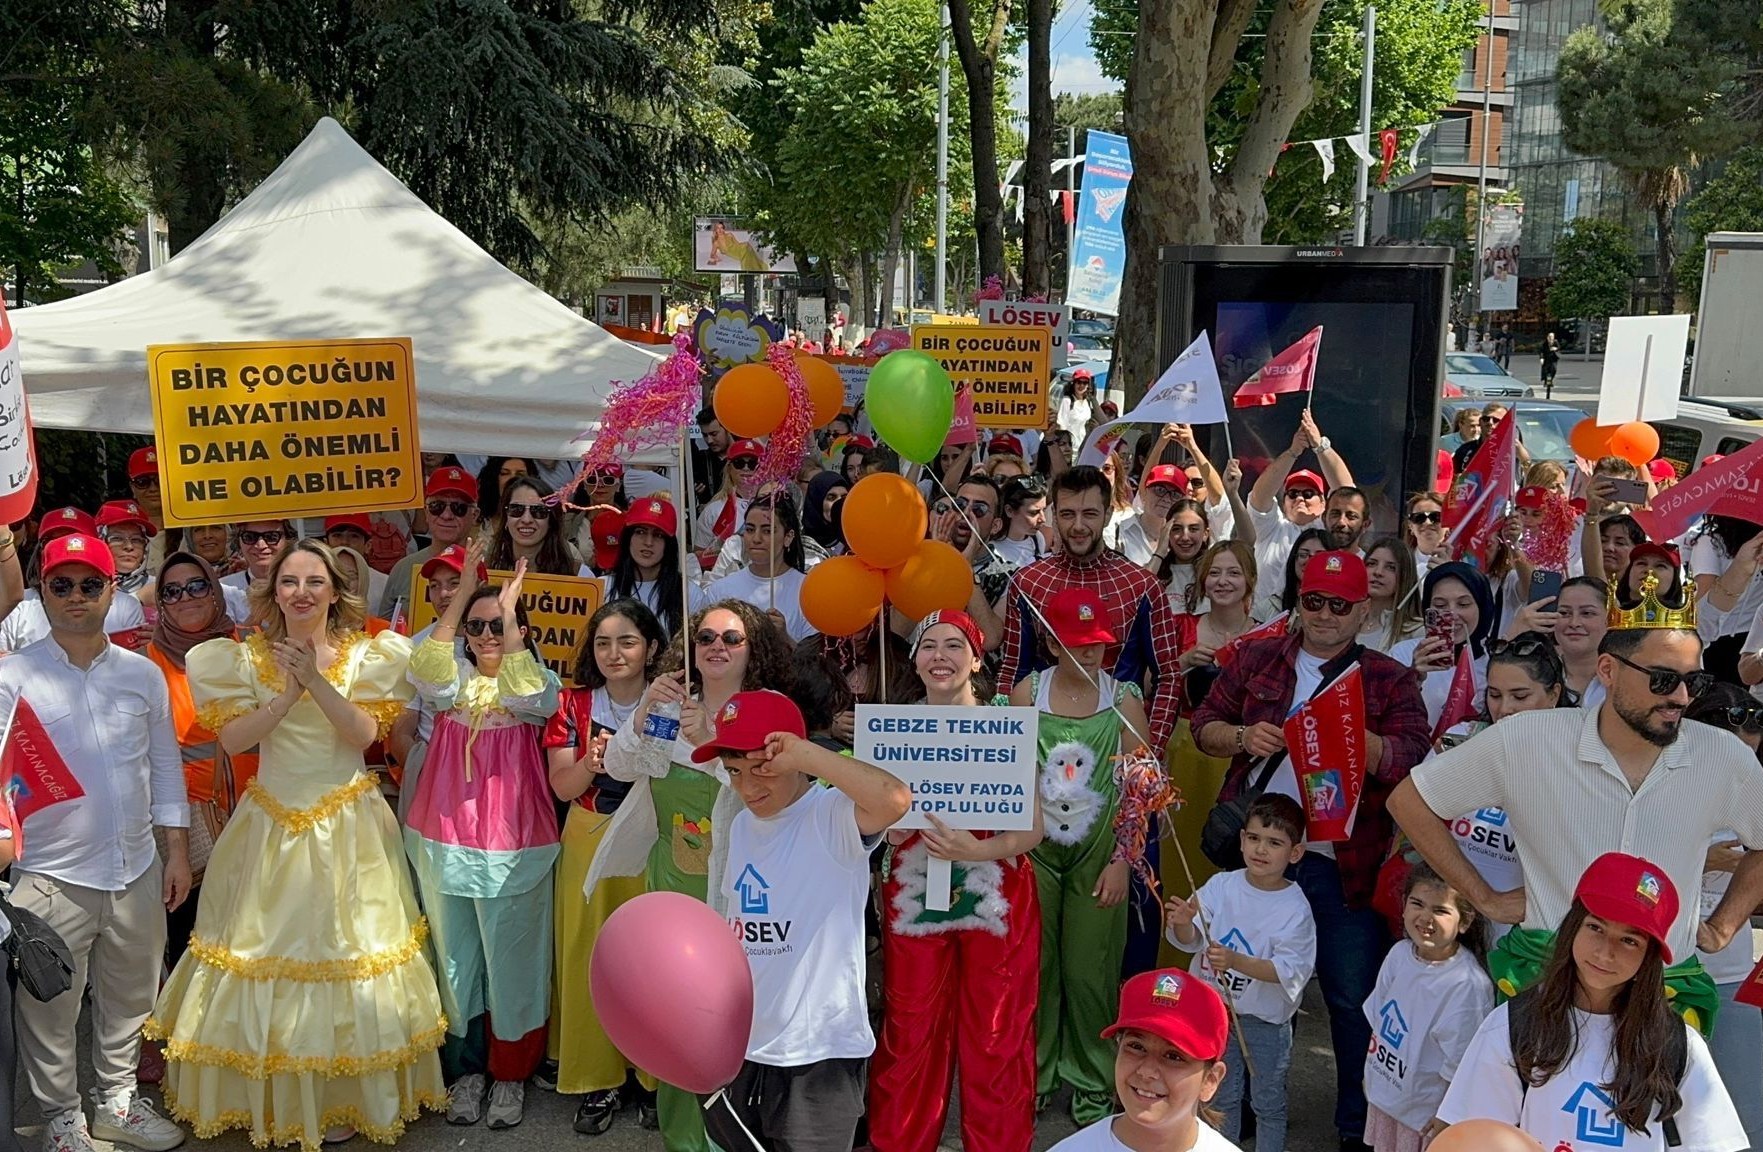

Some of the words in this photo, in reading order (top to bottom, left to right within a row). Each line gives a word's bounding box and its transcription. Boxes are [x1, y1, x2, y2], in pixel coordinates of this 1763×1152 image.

[988, 306, 1061, 327] LÖSEV
[921, 335, 950, 350] BİR
[955, 336, 1041, 354] ÇOCUĞUN
[170, 363, 228, 391] BİR
[239, 356, 396, 393] ÇOCUĞUN
[934, 358, 1033, 373] AYATINDAN
[972, 378, 1039, 395] ÖNEMLİ
[187, 397, 387, 428] HAYATINDAN
[972, 402, 1037, 416] ABİLİR?
[178, 439, 270, 465] DAHA
[280, 427, 401, 459] ÖNEMLİ
[184, 479, 229, 502] NE
[240, 464, 402, 496] OLABİLİR?
[520, 589, 588, 616] UĞUN
[867, 717, 938, 734] GEBZE
[945, 716, 1025, 735] TEKNİK
[1301, 704, 1321, 768] LÖSEV
[873, 743, 1017, 763] ÜNİVERSİTESİ
[909, 779, 966, 795] LÖSEV
[970, 783, 1025, 796] FAYDA
[911, 798, 1024, 814] TOPLULUĞU
[1450, 816, 1517, 853] ÖSEV
[729, 916, 792, 943] ÖSEV
